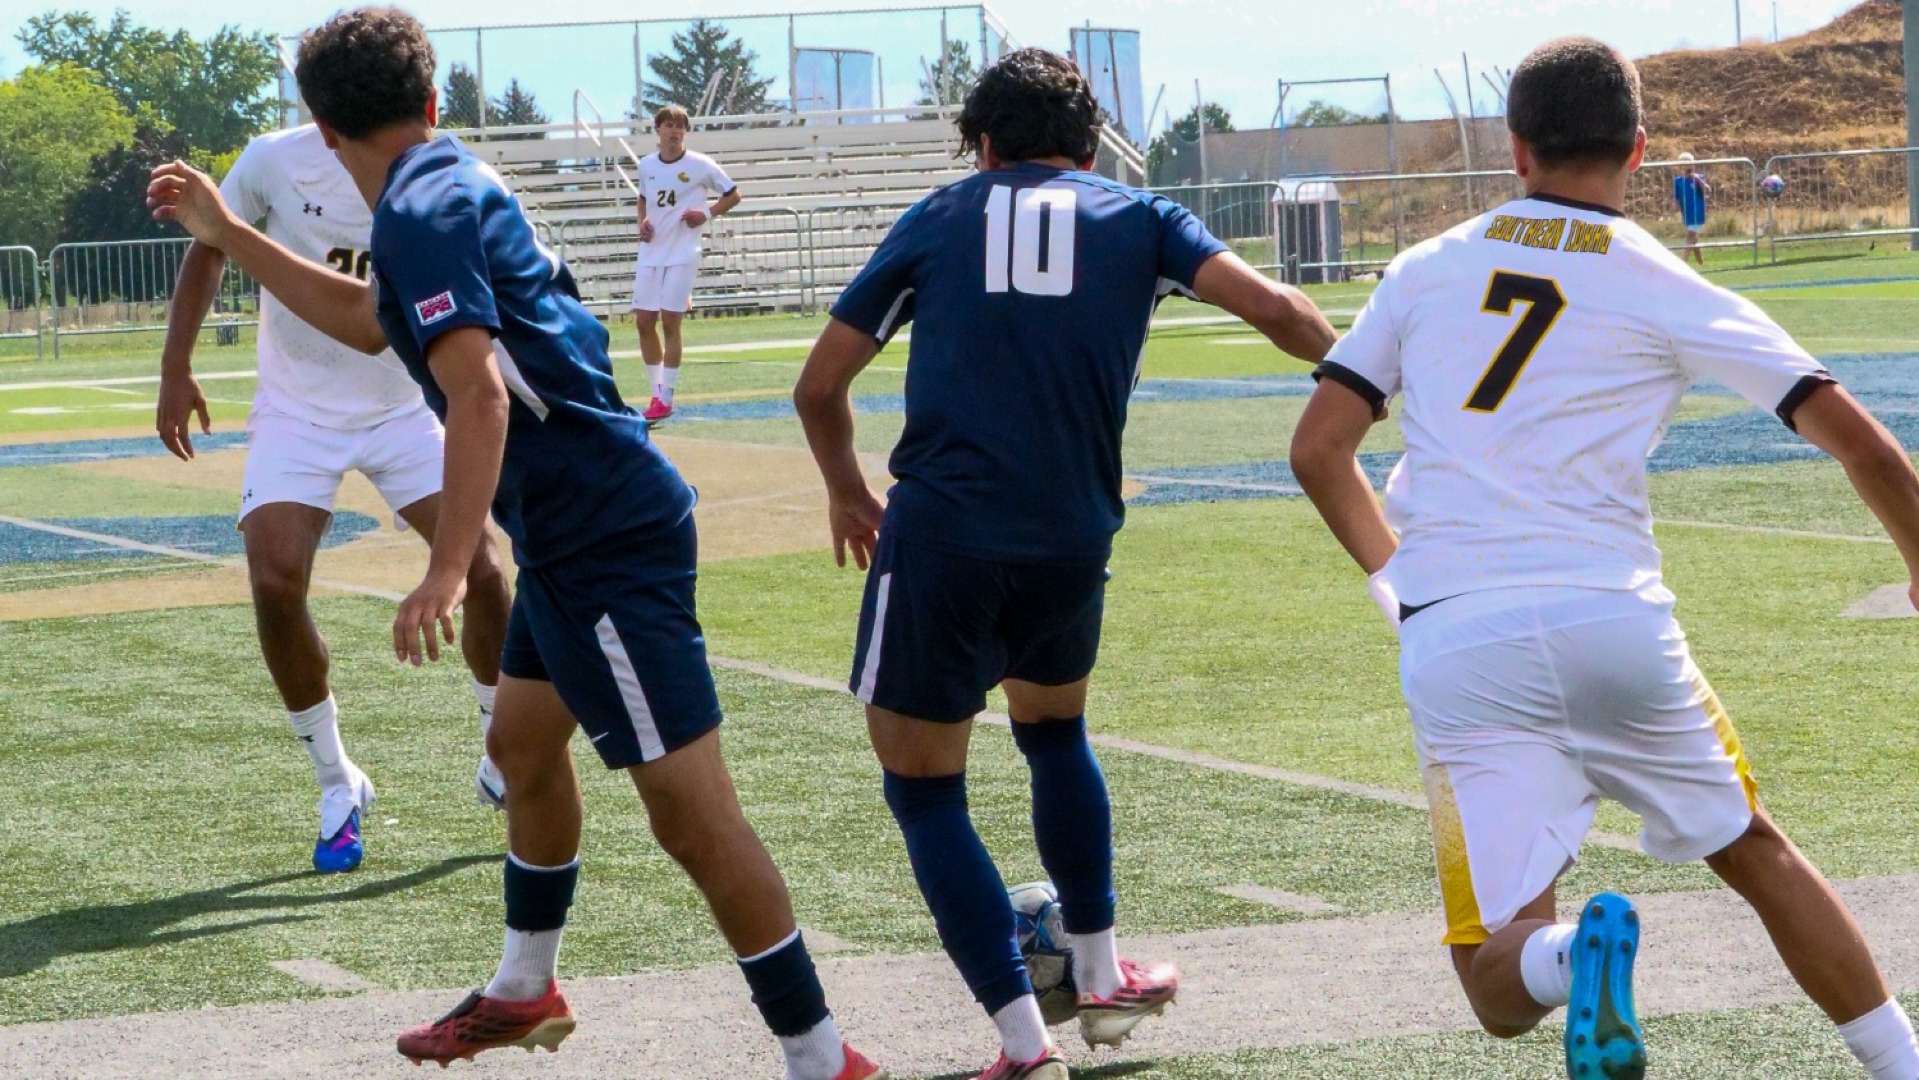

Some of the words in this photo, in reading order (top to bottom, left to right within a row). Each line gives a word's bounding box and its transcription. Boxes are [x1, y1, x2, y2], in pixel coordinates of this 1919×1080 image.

[657, 189, 677, 207] 24
[1484, 214, 1567, 251] SOUTHERN
[1562, 218, 1613, 255] IDAHO
[984, 183, 1077, 297] 10
[1461, 267, 1568, 414] 7
